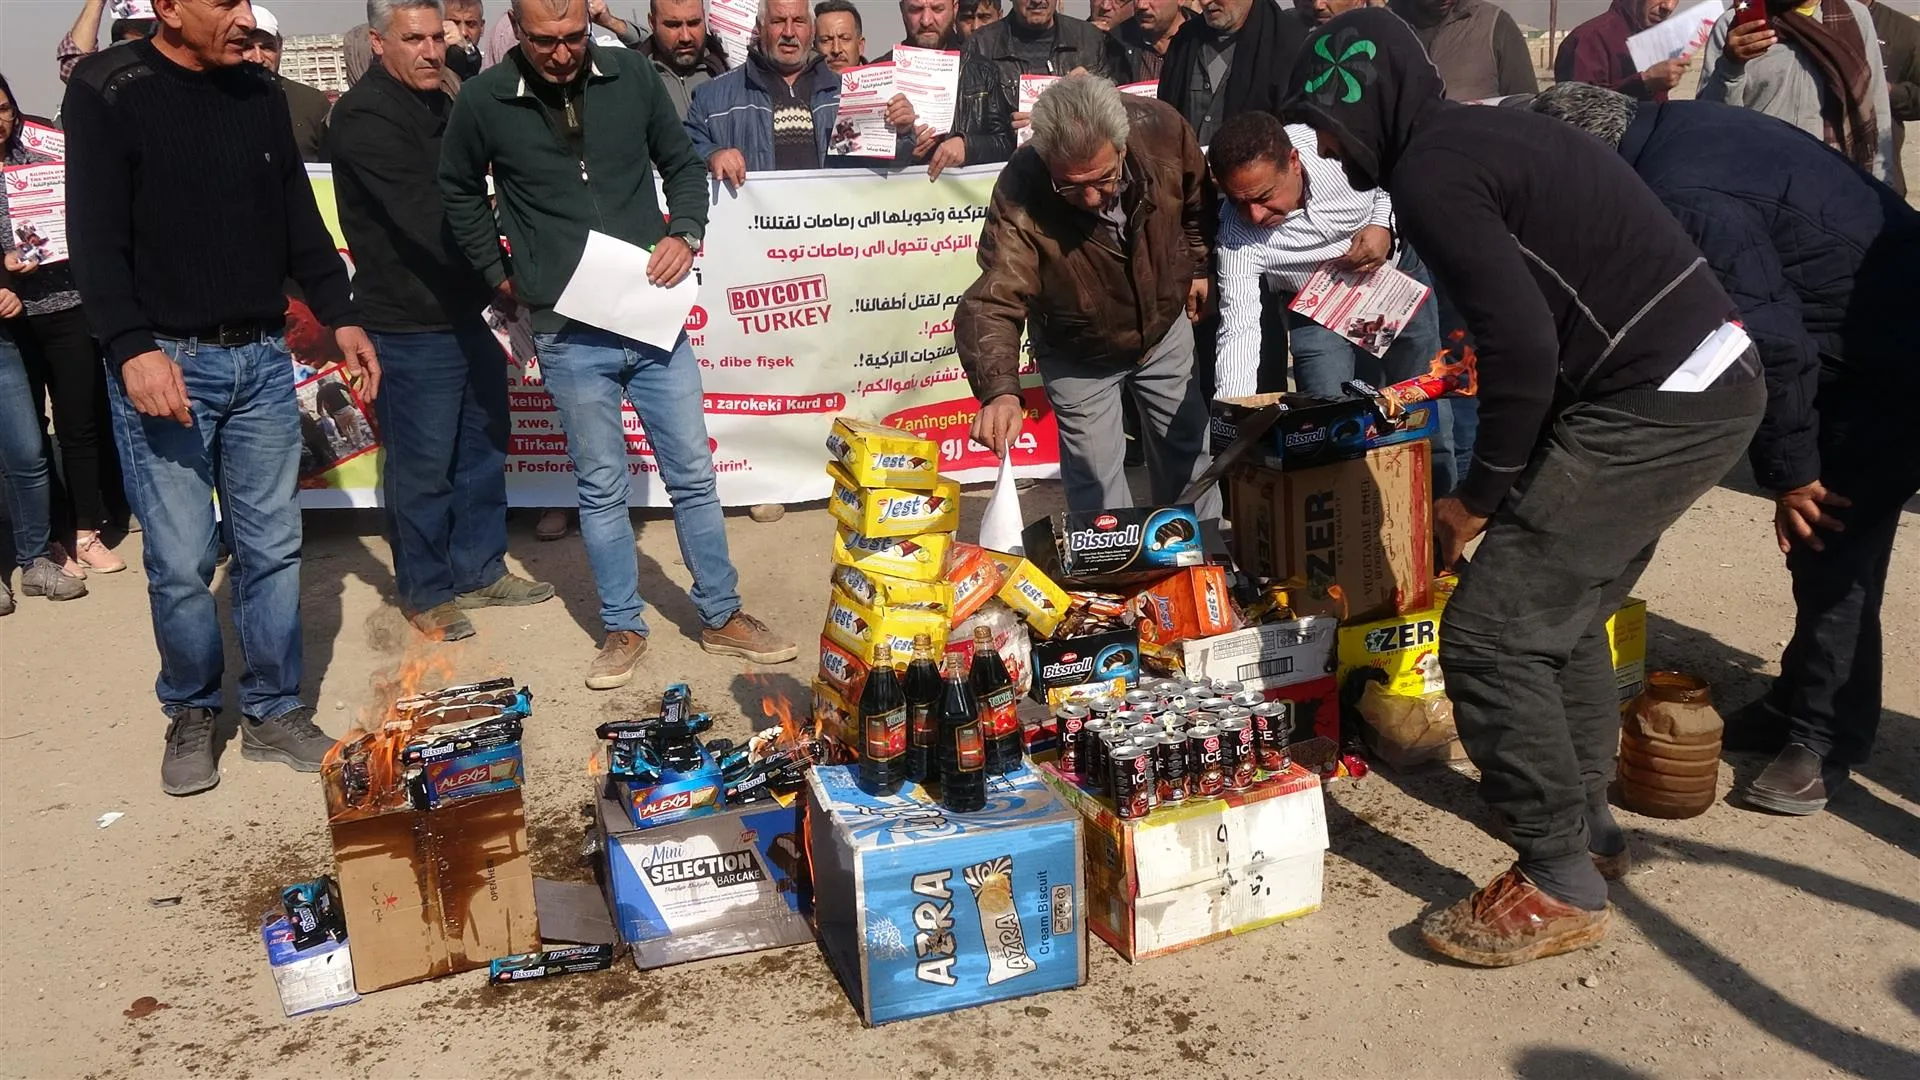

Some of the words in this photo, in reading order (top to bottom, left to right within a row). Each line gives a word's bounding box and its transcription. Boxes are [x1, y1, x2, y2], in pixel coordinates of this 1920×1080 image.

[804, 215, 854, 230] رصاصات
[883, 208, 945, 228] وتحويلها
[767, 246, 803, 262] توجه
[807, 243, 859, 259] رصاصات
[888, 237, 928, 257] تتحول
[931, 235, 972, 256] التركي
[731, 279, 822, 310] BOYCOTT
[909, 293, 941, 311] لقتل
[737, 304, 832, 335] TURKEY
[719, 355, 752, 368] dibe
[756, 355, 794, 369] fîşek
[717, 397, 782, 411] zarokekî
[786, 396, 820, 410] Kurd
[825, 396, 838, 410] e!
[1211, 416, 1238, 439] Bissro
[1286, 427, 1327, 447] Bissroll
[872, 454, 906, 470] Jest
[878, 496, 921, 523] Jest
[1072, 525, 1139, 550] Bissroll
[1304, 491, 1336, 584] ZER
[1015, 579, 1042, 602] Jest
[831, 604, 853, 629] Jest
[1151, 593, 1175, 631] Jest
[1206, 598, 1220, 625] Jest
[891, 636, 914, 651] Jest
[1380, 620, 1434, 652] ZER
[823, 650, 844, 674] Jest
[1043, 657, 1093, 679] Bissroll
[422, 743, 455, 758] Bissroll
[1201, 750, 1222, 763] ICE
[1236, 744, 1251, 756] IC
[439, 767, 488, 791] ALEXIS
[738, 773, 767, 793] Bissroll
[1131, 772, 1145, 785] IC
[641, 794, 689, 816] ALEXIS
[643, 845, 684, 868] Mini
[651, 852, 752, 884] SELECTION
[717, 875, 736, 887] BAR
[736, 869, 760, 882] CAKE
[489, 879, 499, 902] OPEN
[1036, 869, 1049, 907] Biscuit
[911, 868, 958, 987] AZRA
[1039, 910, 1050, 955] Cream
[995, 913, 1028, 970] AZRA
[512, 966, 545, 979] Bissroll
